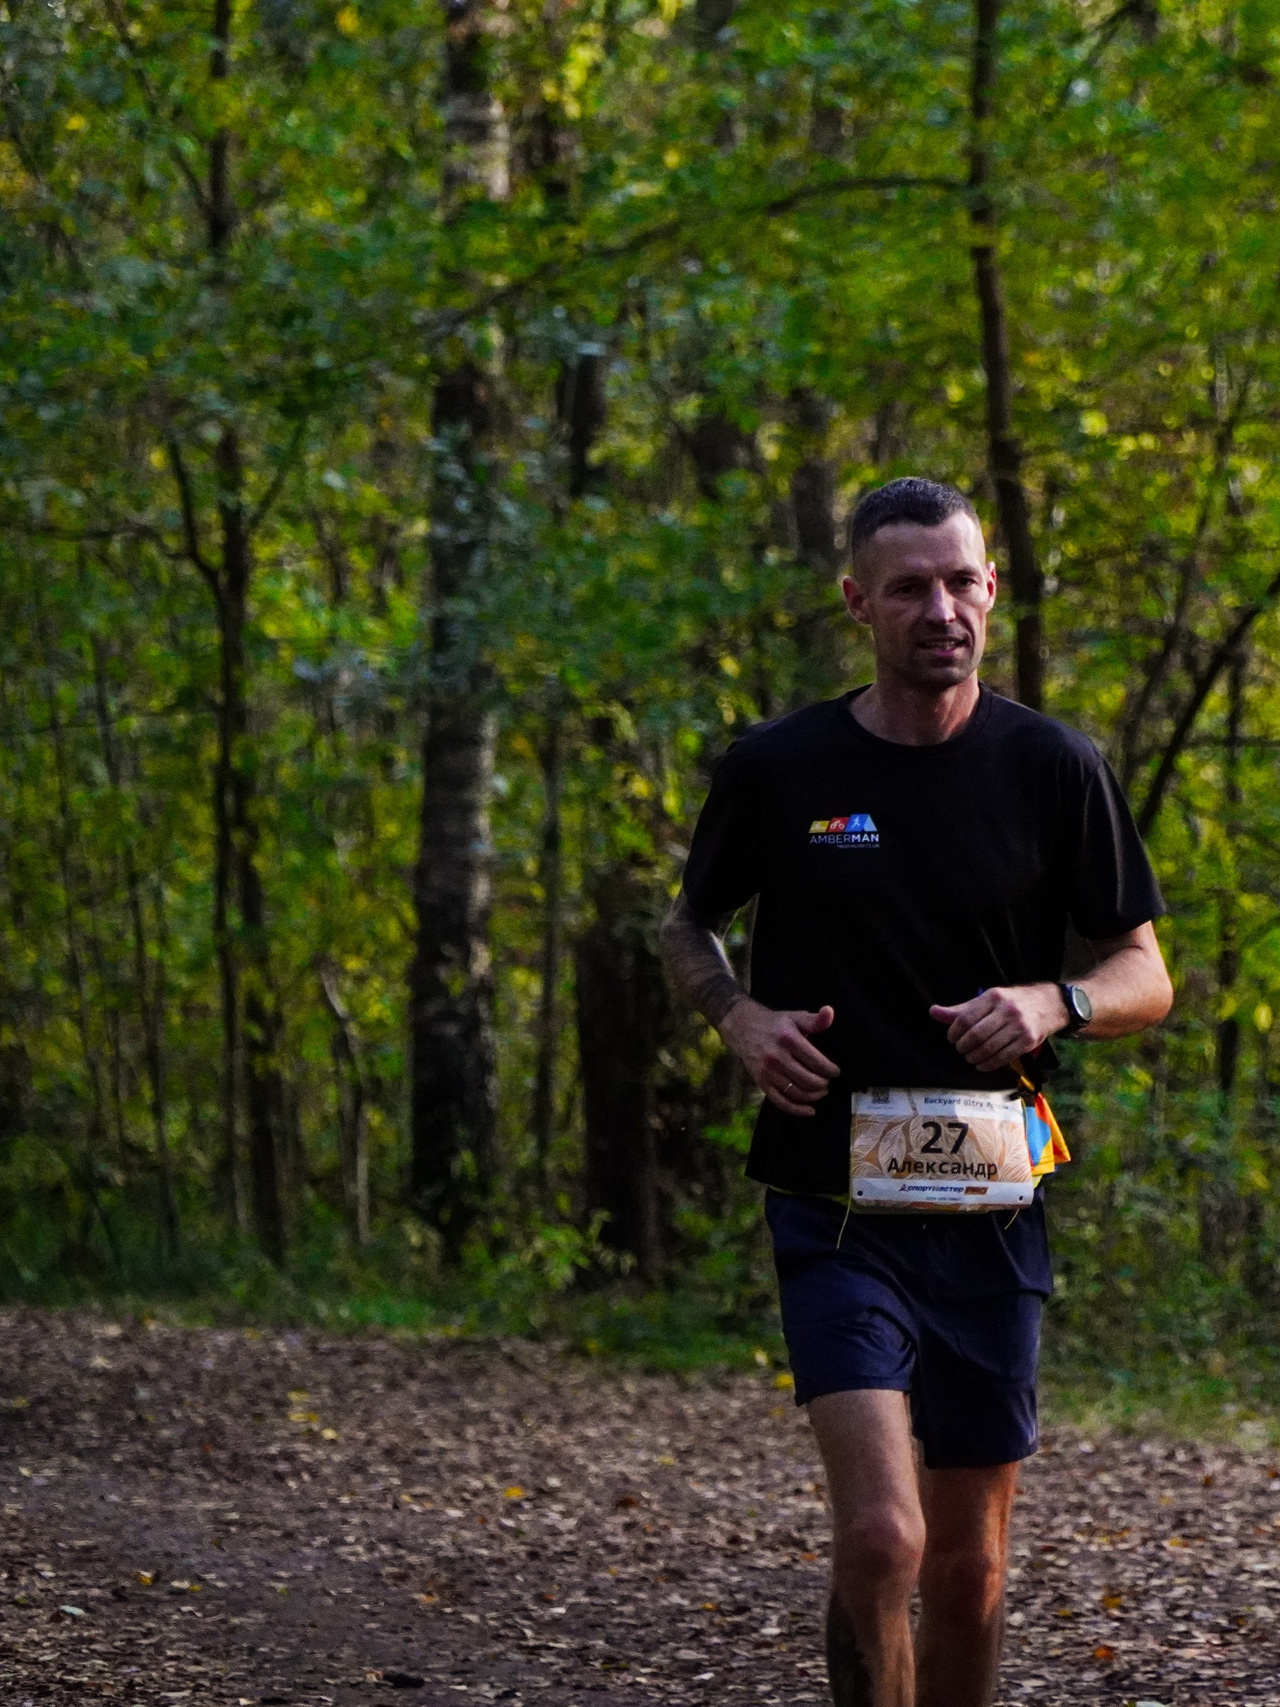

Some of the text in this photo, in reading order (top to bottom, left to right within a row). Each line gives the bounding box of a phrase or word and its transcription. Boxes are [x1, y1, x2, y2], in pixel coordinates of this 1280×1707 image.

[809, 834, 880, 844] AMBERMAN
[924, 1097, 961, 1107] Backyard
[920, 1121, 969, 1154] 27
[887, 1157, 998, 1179] Александр
